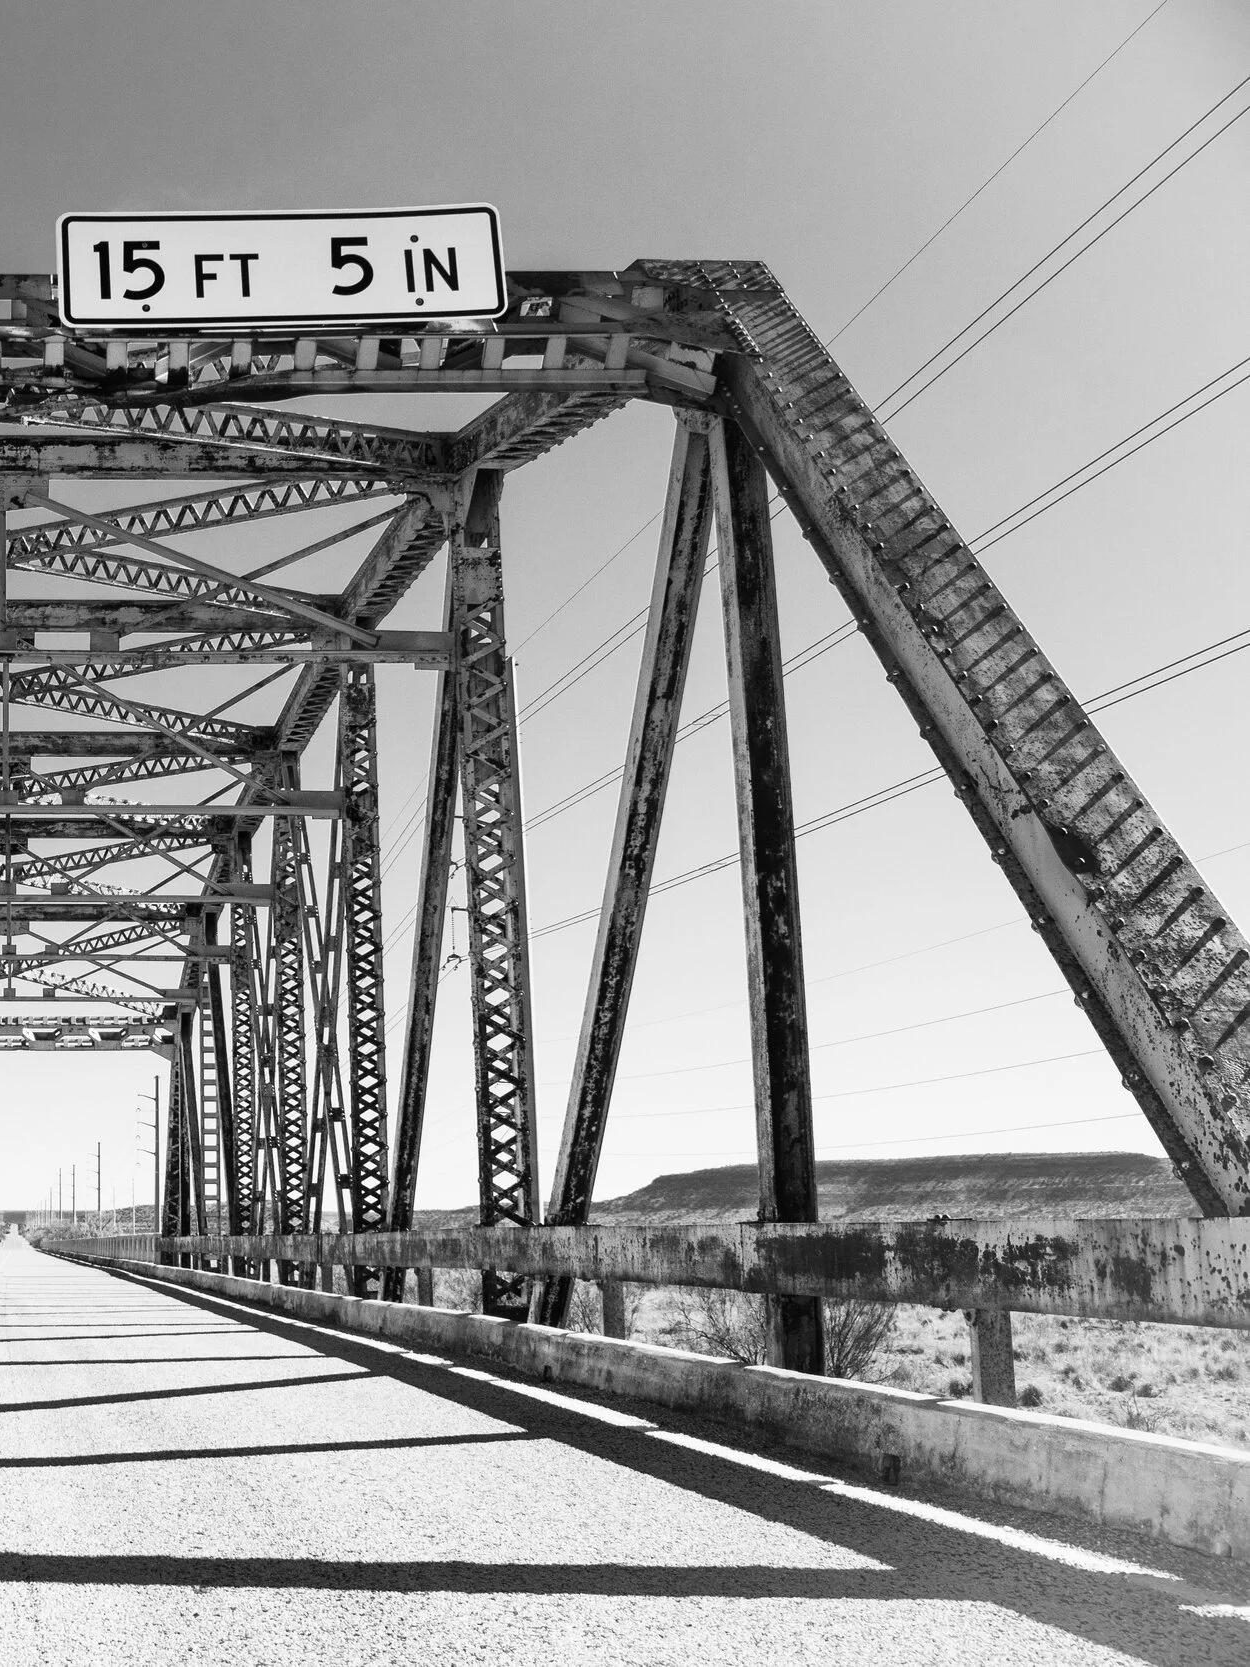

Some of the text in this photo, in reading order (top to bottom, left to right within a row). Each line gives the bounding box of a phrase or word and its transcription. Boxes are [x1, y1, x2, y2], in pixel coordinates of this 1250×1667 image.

[93, 236, 459, 300] 15 FT 5 IN
